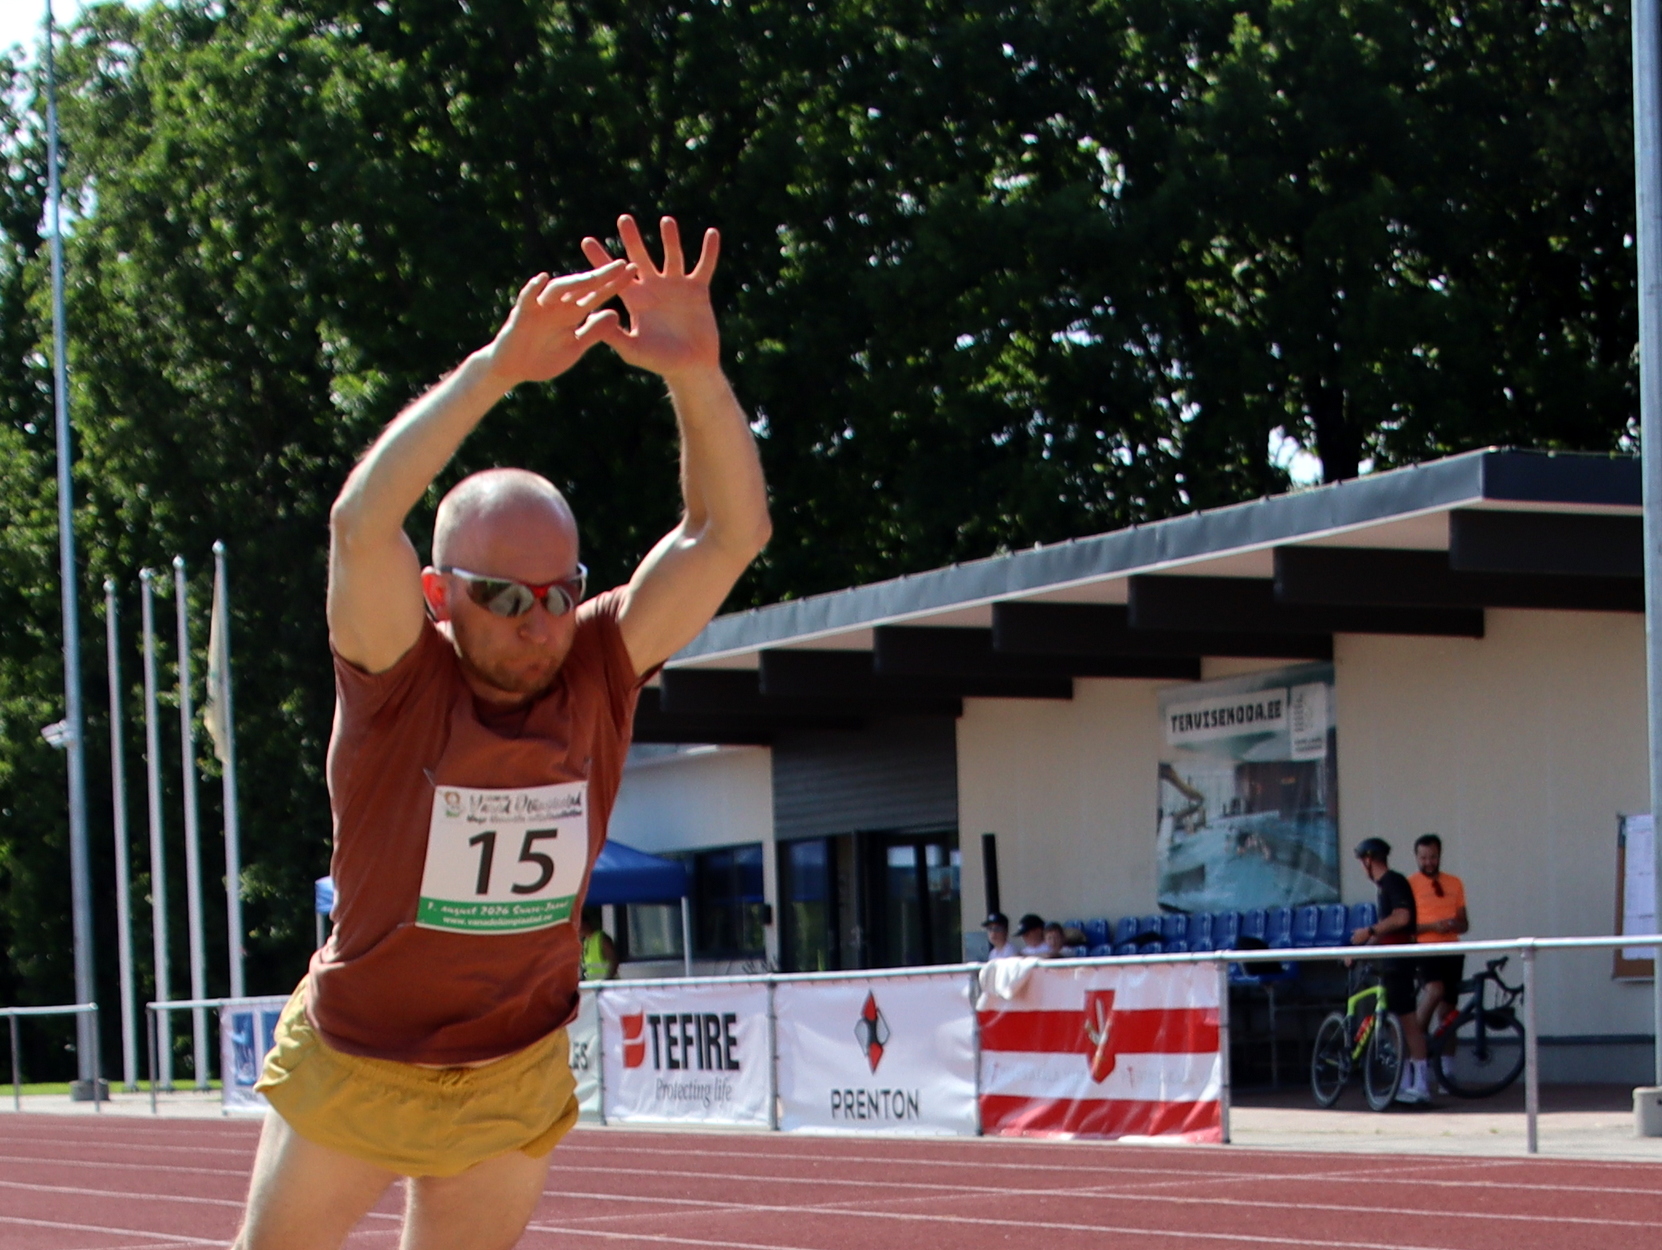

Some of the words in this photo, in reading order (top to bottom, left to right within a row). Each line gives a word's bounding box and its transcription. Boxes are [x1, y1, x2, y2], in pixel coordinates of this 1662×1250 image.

[468, 828, 558, 895] 15
[646, 1012, 740, 1070] TEFIRE
[655, 1078, 711, 1106] Protecting
[714, 1079, 732, 1101] life
[830, 1088, 919, 1119] PRENTON
